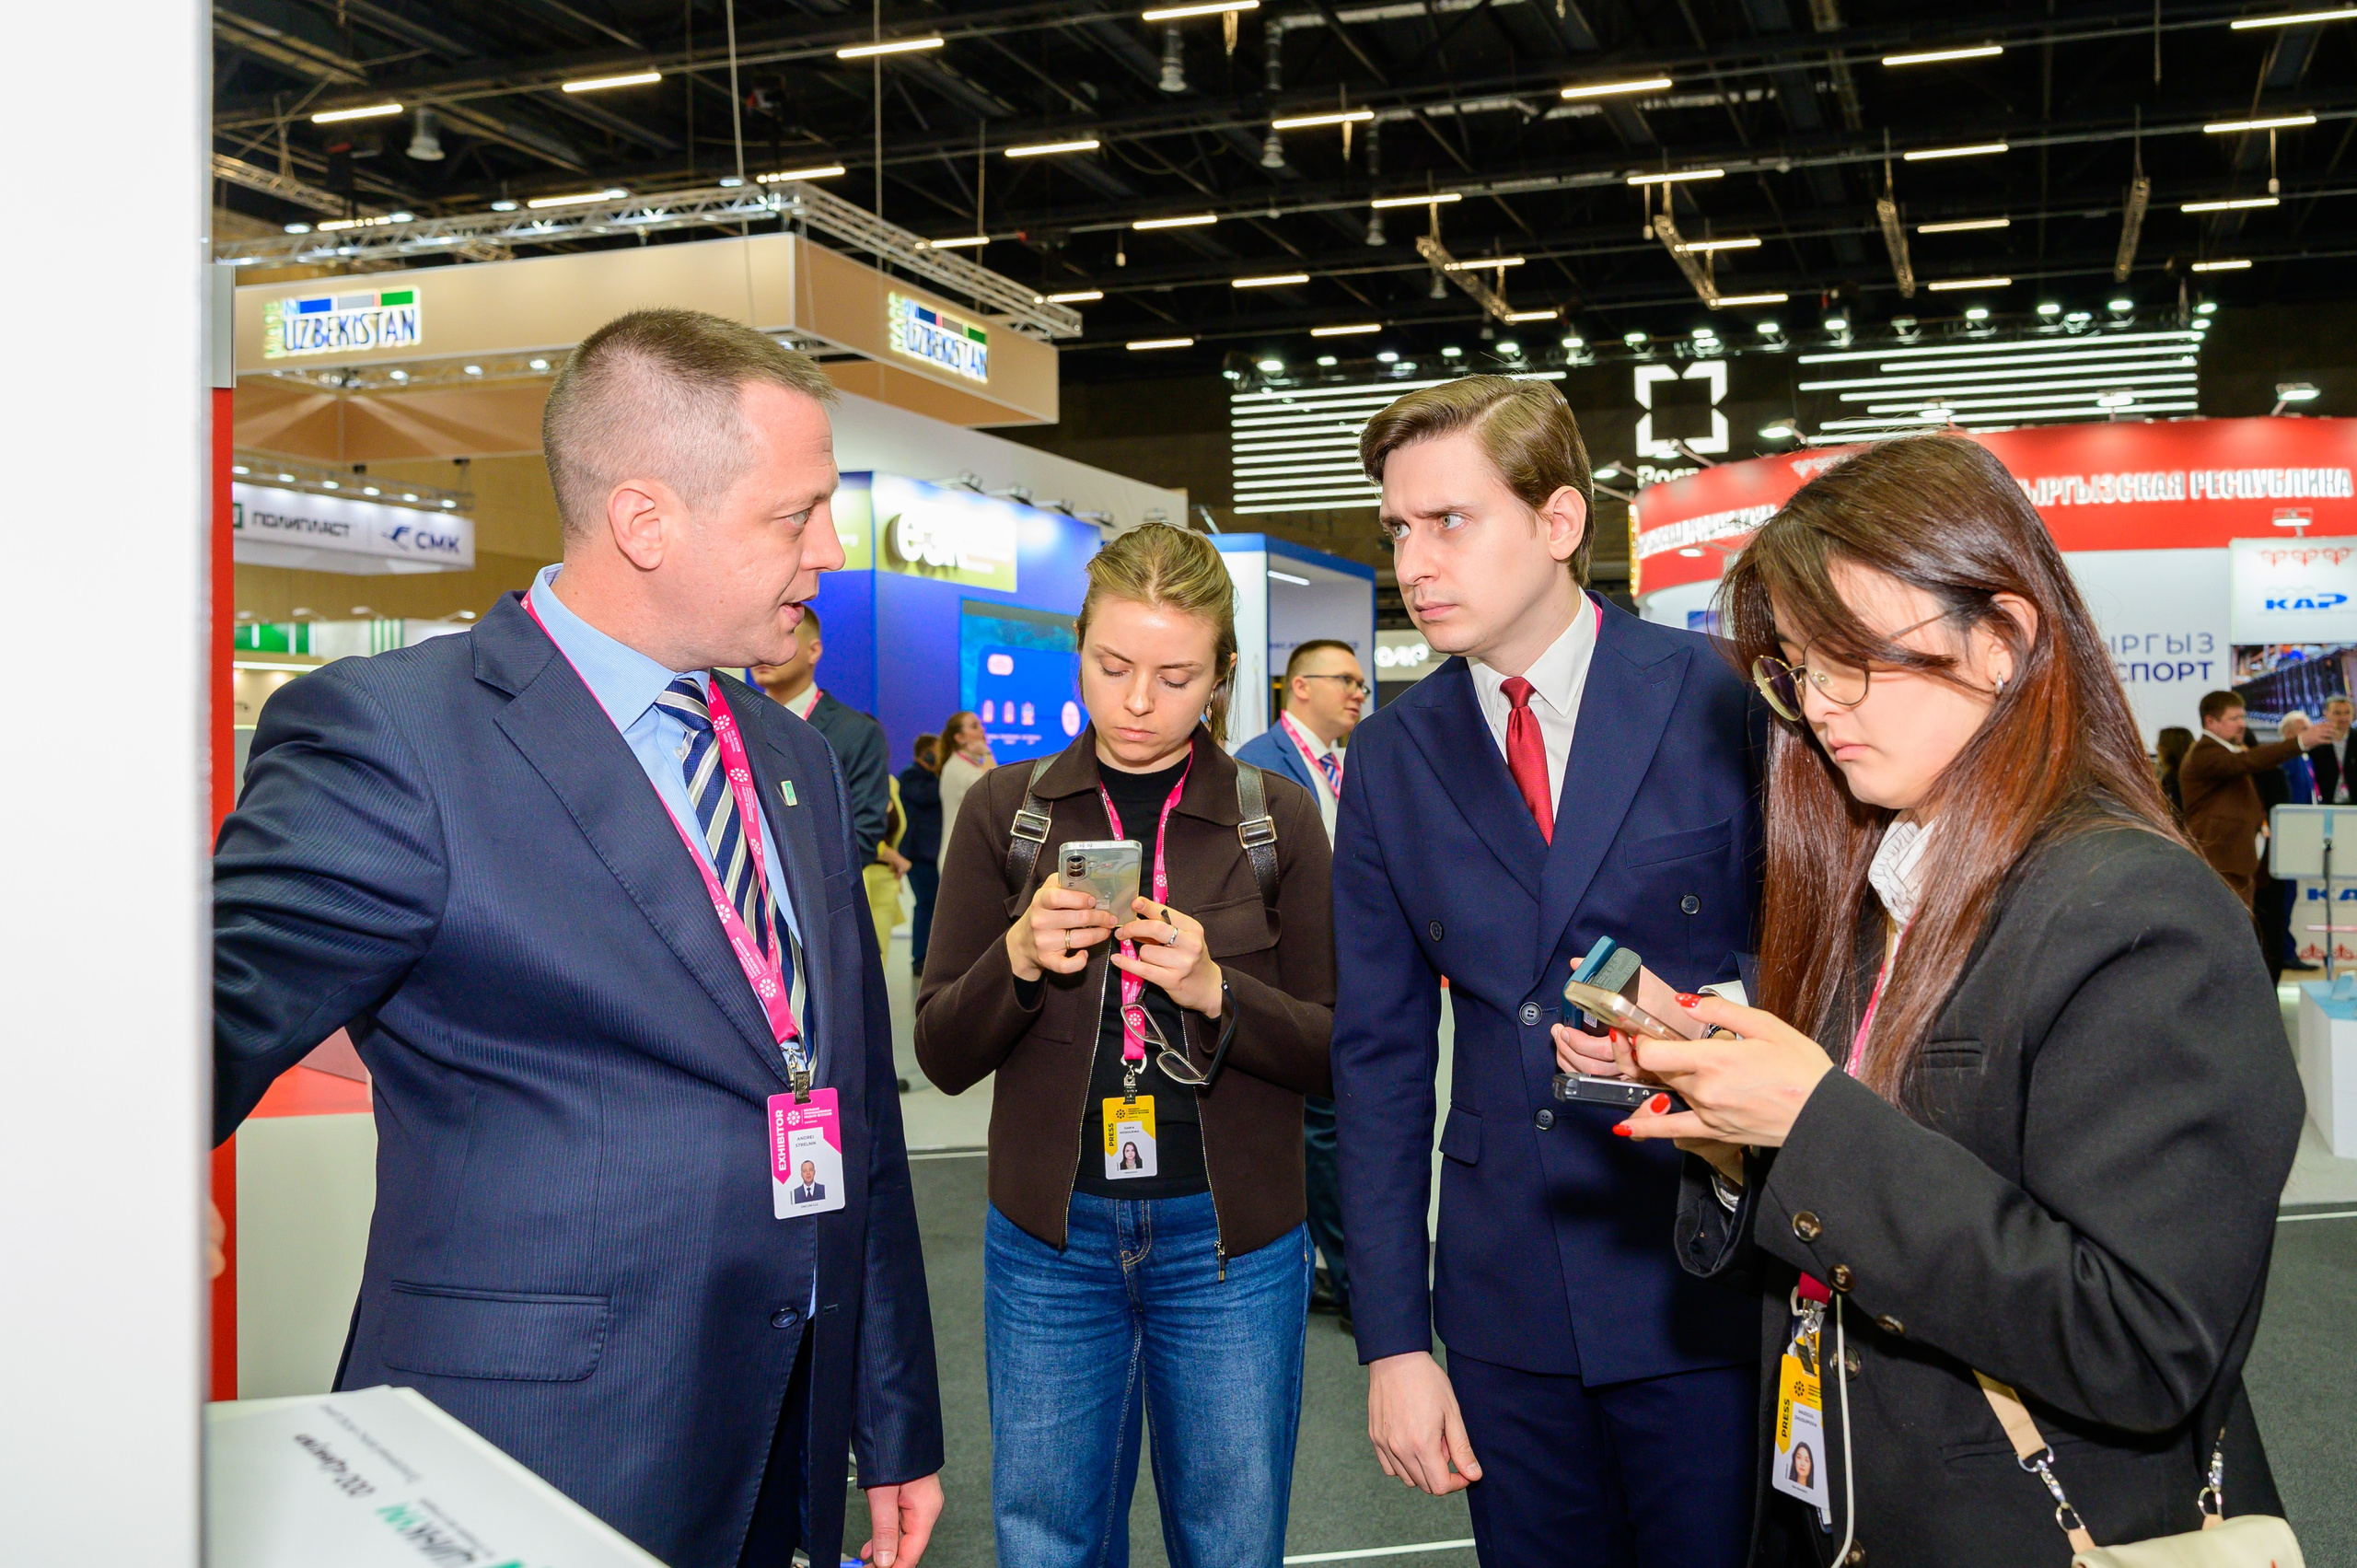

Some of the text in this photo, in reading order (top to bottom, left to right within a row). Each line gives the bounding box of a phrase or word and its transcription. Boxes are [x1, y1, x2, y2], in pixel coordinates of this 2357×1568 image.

[284, 306, 421, 356] UZBEKISTAN
[2019, 468, 2353, 505] ЫРГЫЗСКАЯ РЕСПУБЛИКА
[252, 511, 350, 537] ПОЛИПЛАСТ
[415, 531, 460, 552] СМК
[2110, 633, 2214, 655] РГЫЗ
[2117, 661, 2213, 681] СПОРТ
[775, 1109, 787, 1171] EXHIBITOR
[1782, 1399, 1790, 1438] PRESS
